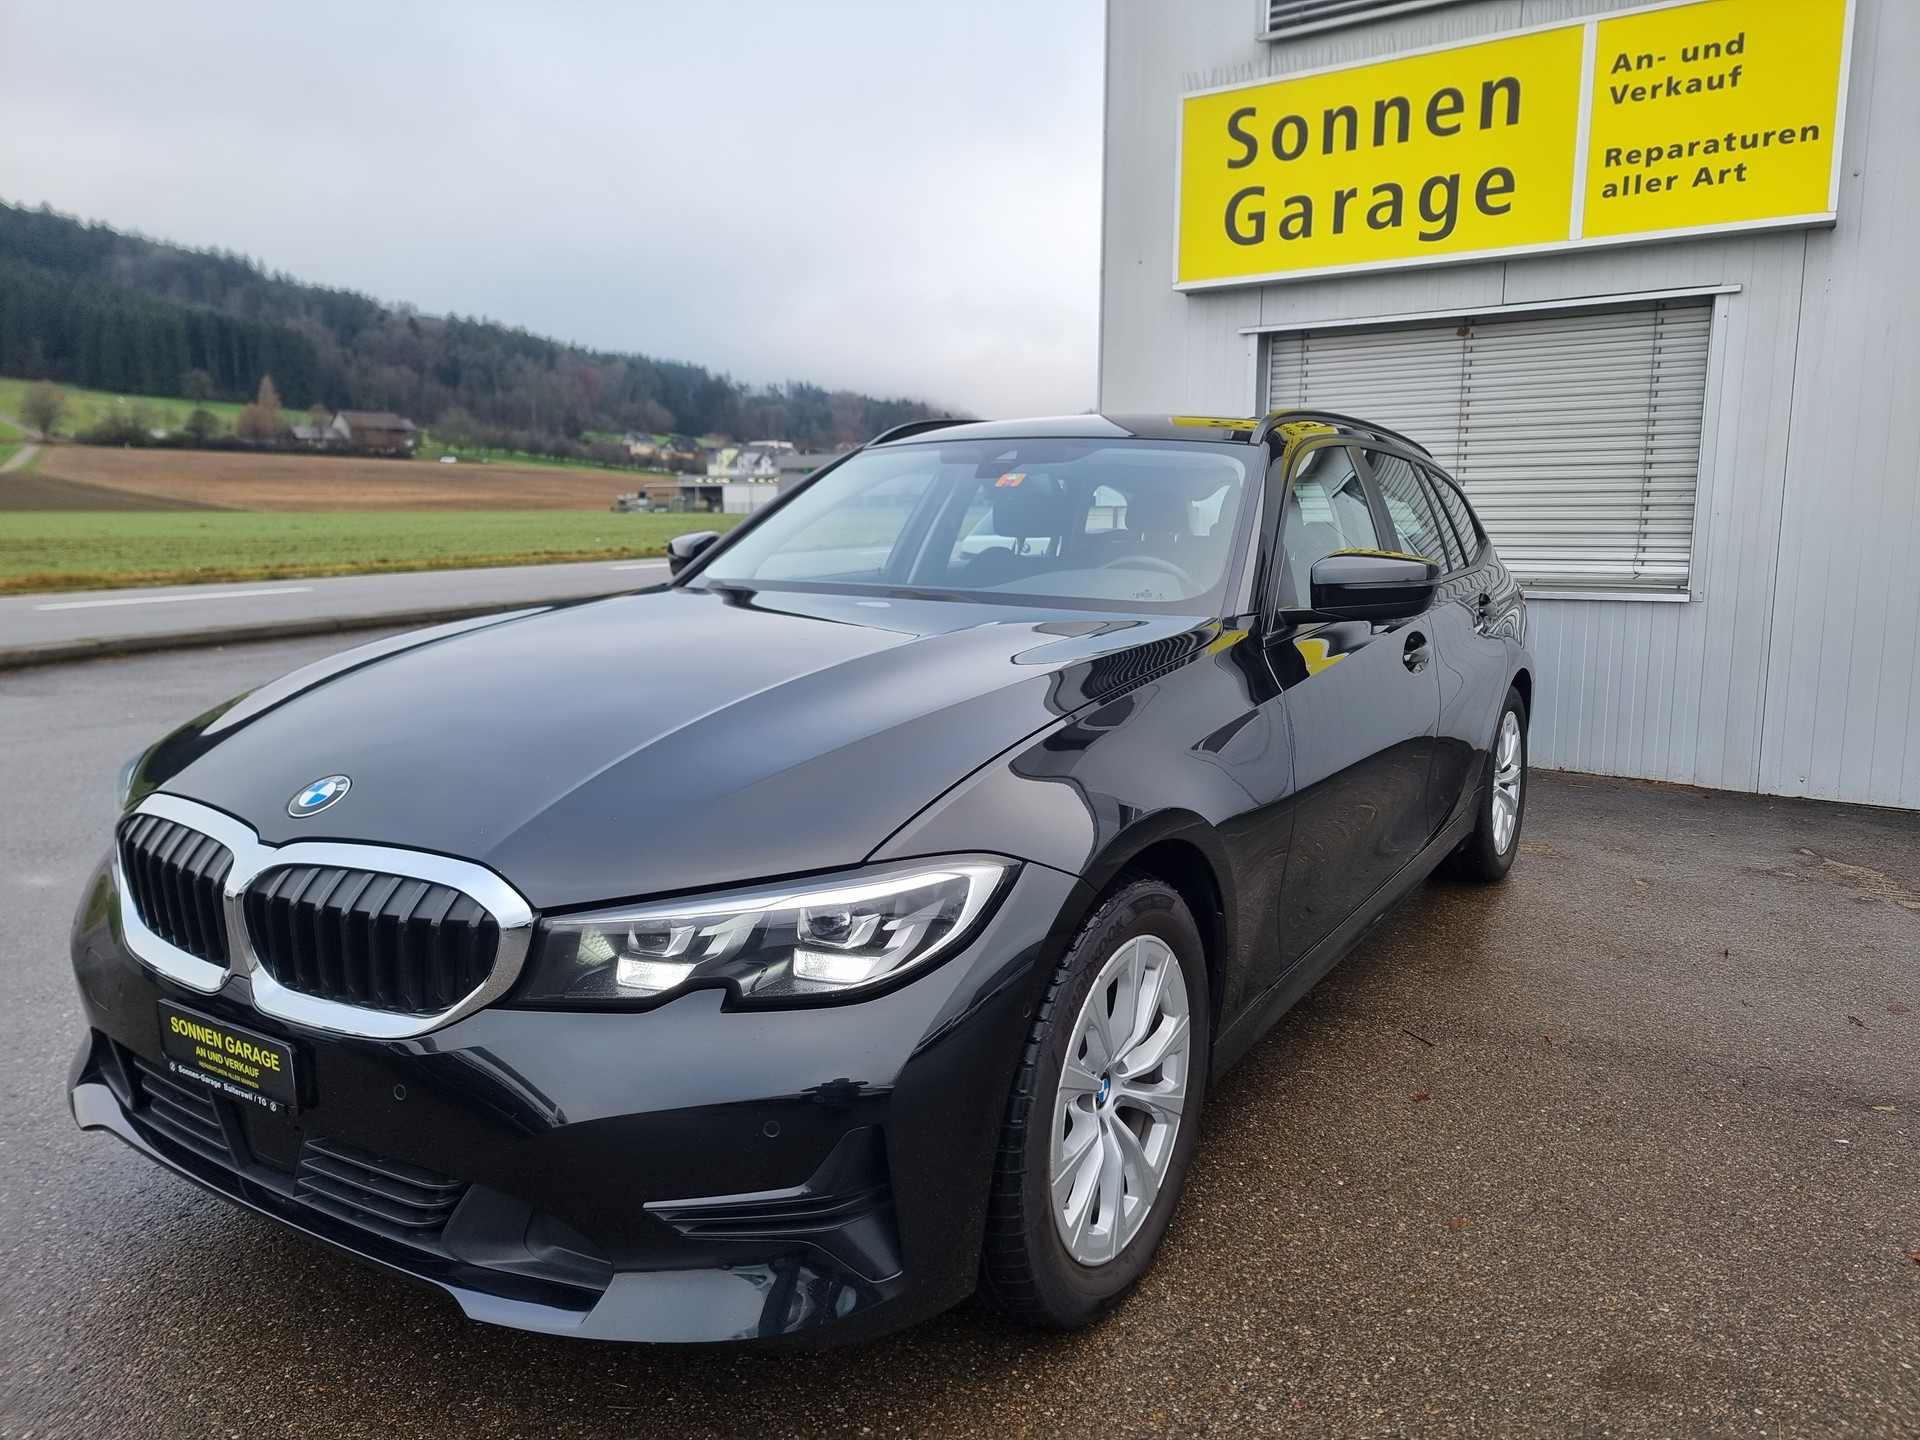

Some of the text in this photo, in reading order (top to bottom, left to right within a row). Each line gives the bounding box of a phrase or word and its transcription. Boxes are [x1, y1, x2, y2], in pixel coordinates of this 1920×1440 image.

[1611, 32, 1745, 75] An- und
[1609, 64, 1743, 105] Verkauf
[1227, 76, 1521, 169] Sonnen
[1604, 125, 1820, 168] Reparaturen
[1601, 162, 1747, 199] aller Art
[1224, 166, 1515, 246] Garage
[170, 1016, 281, 1072] SONNEN GARAGE
[196, 1046, 260, 1079] AN UND VERKAUF
[177, 1064, 222, 1089] Sonnen-Garage
[257, 1096, 267, 1107] TG
